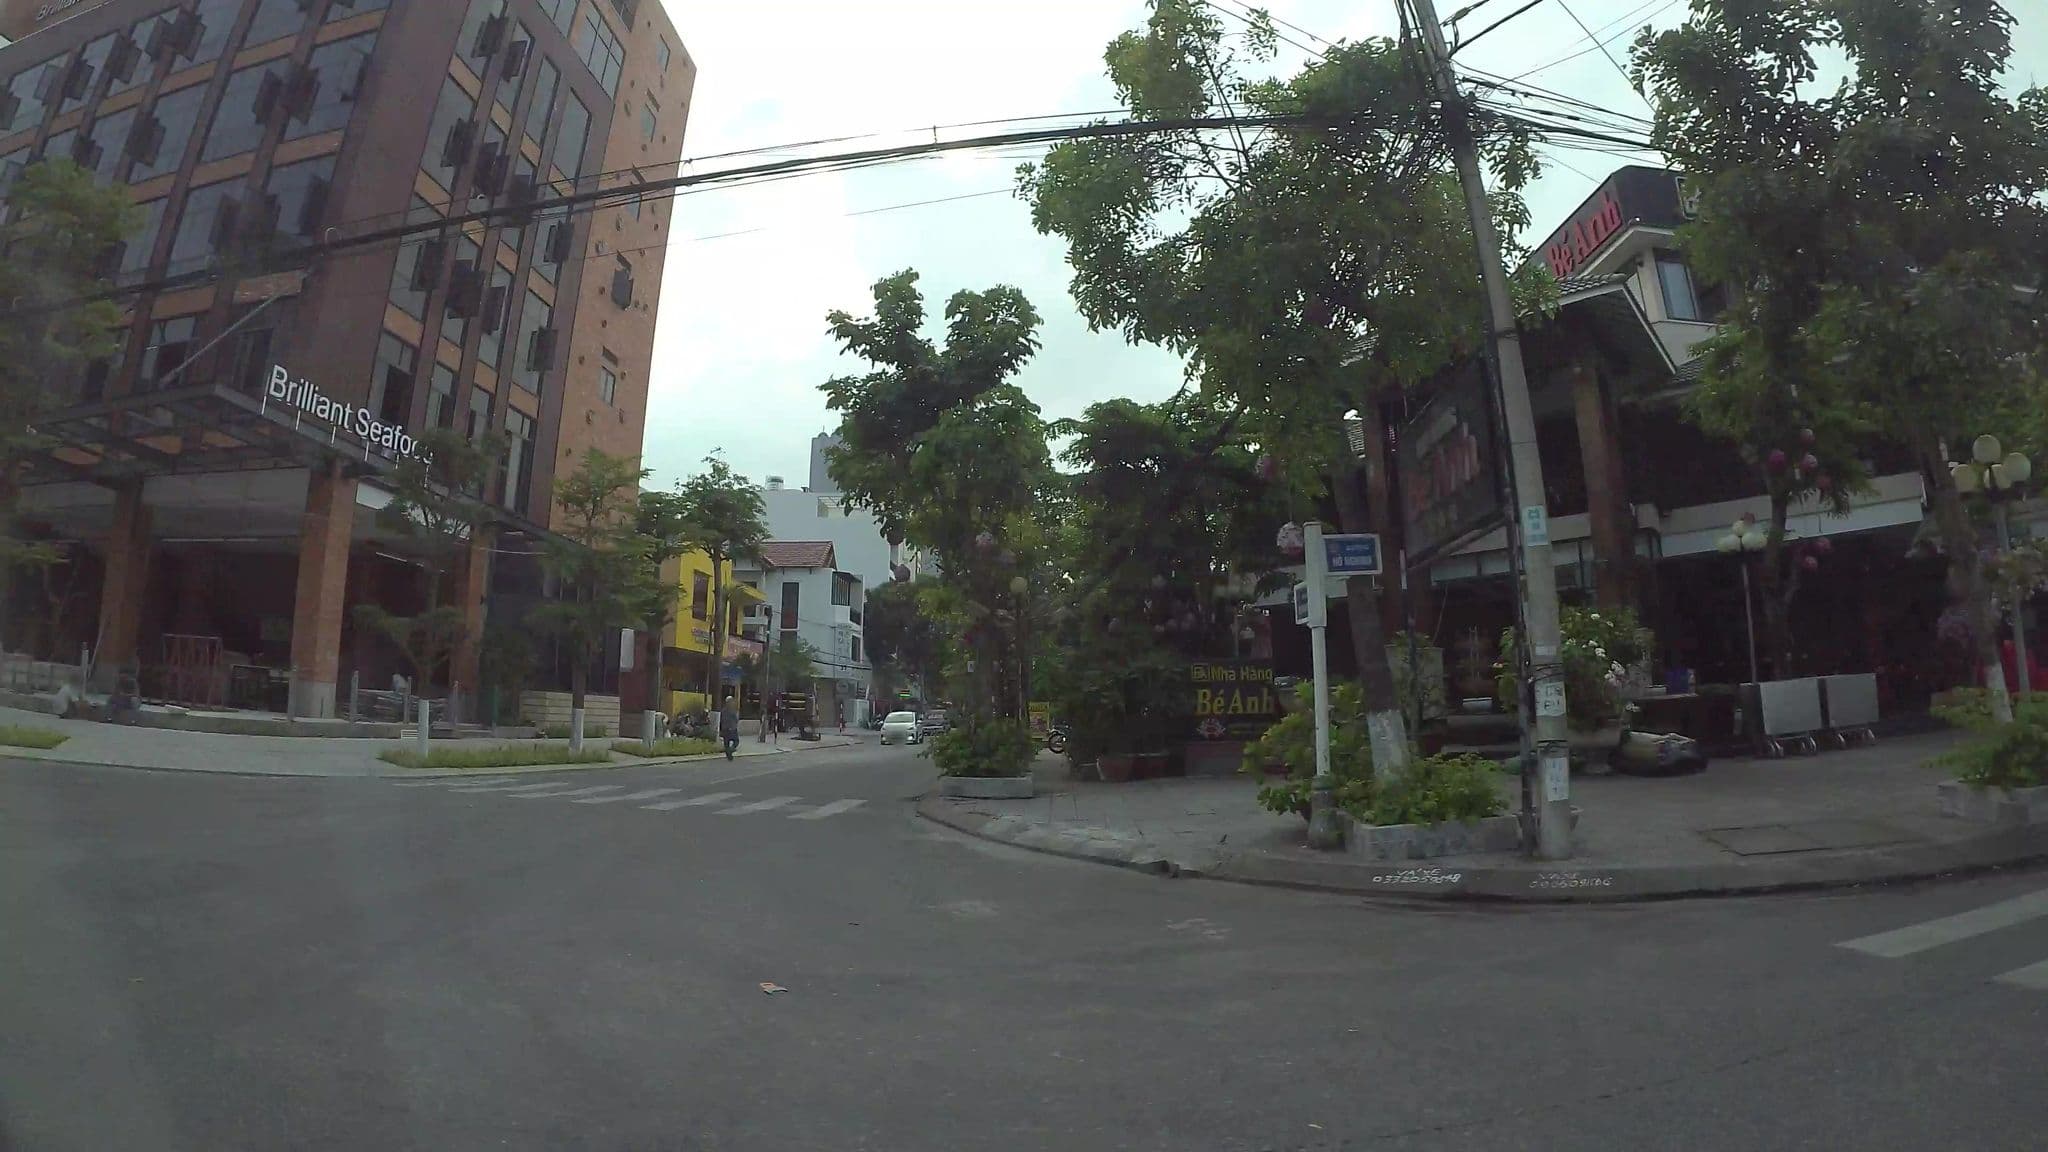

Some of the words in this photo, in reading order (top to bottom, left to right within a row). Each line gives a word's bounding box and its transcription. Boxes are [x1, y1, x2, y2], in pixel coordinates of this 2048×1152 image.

[1546, 227, 1575, 278] Bé
[1573, 191, 1623, 265] Anh
[269, 364, 354, 429] Brilliant
[1196, 688, 1225, 714] Bé
[1227, 688, 1274, 714] Anh
